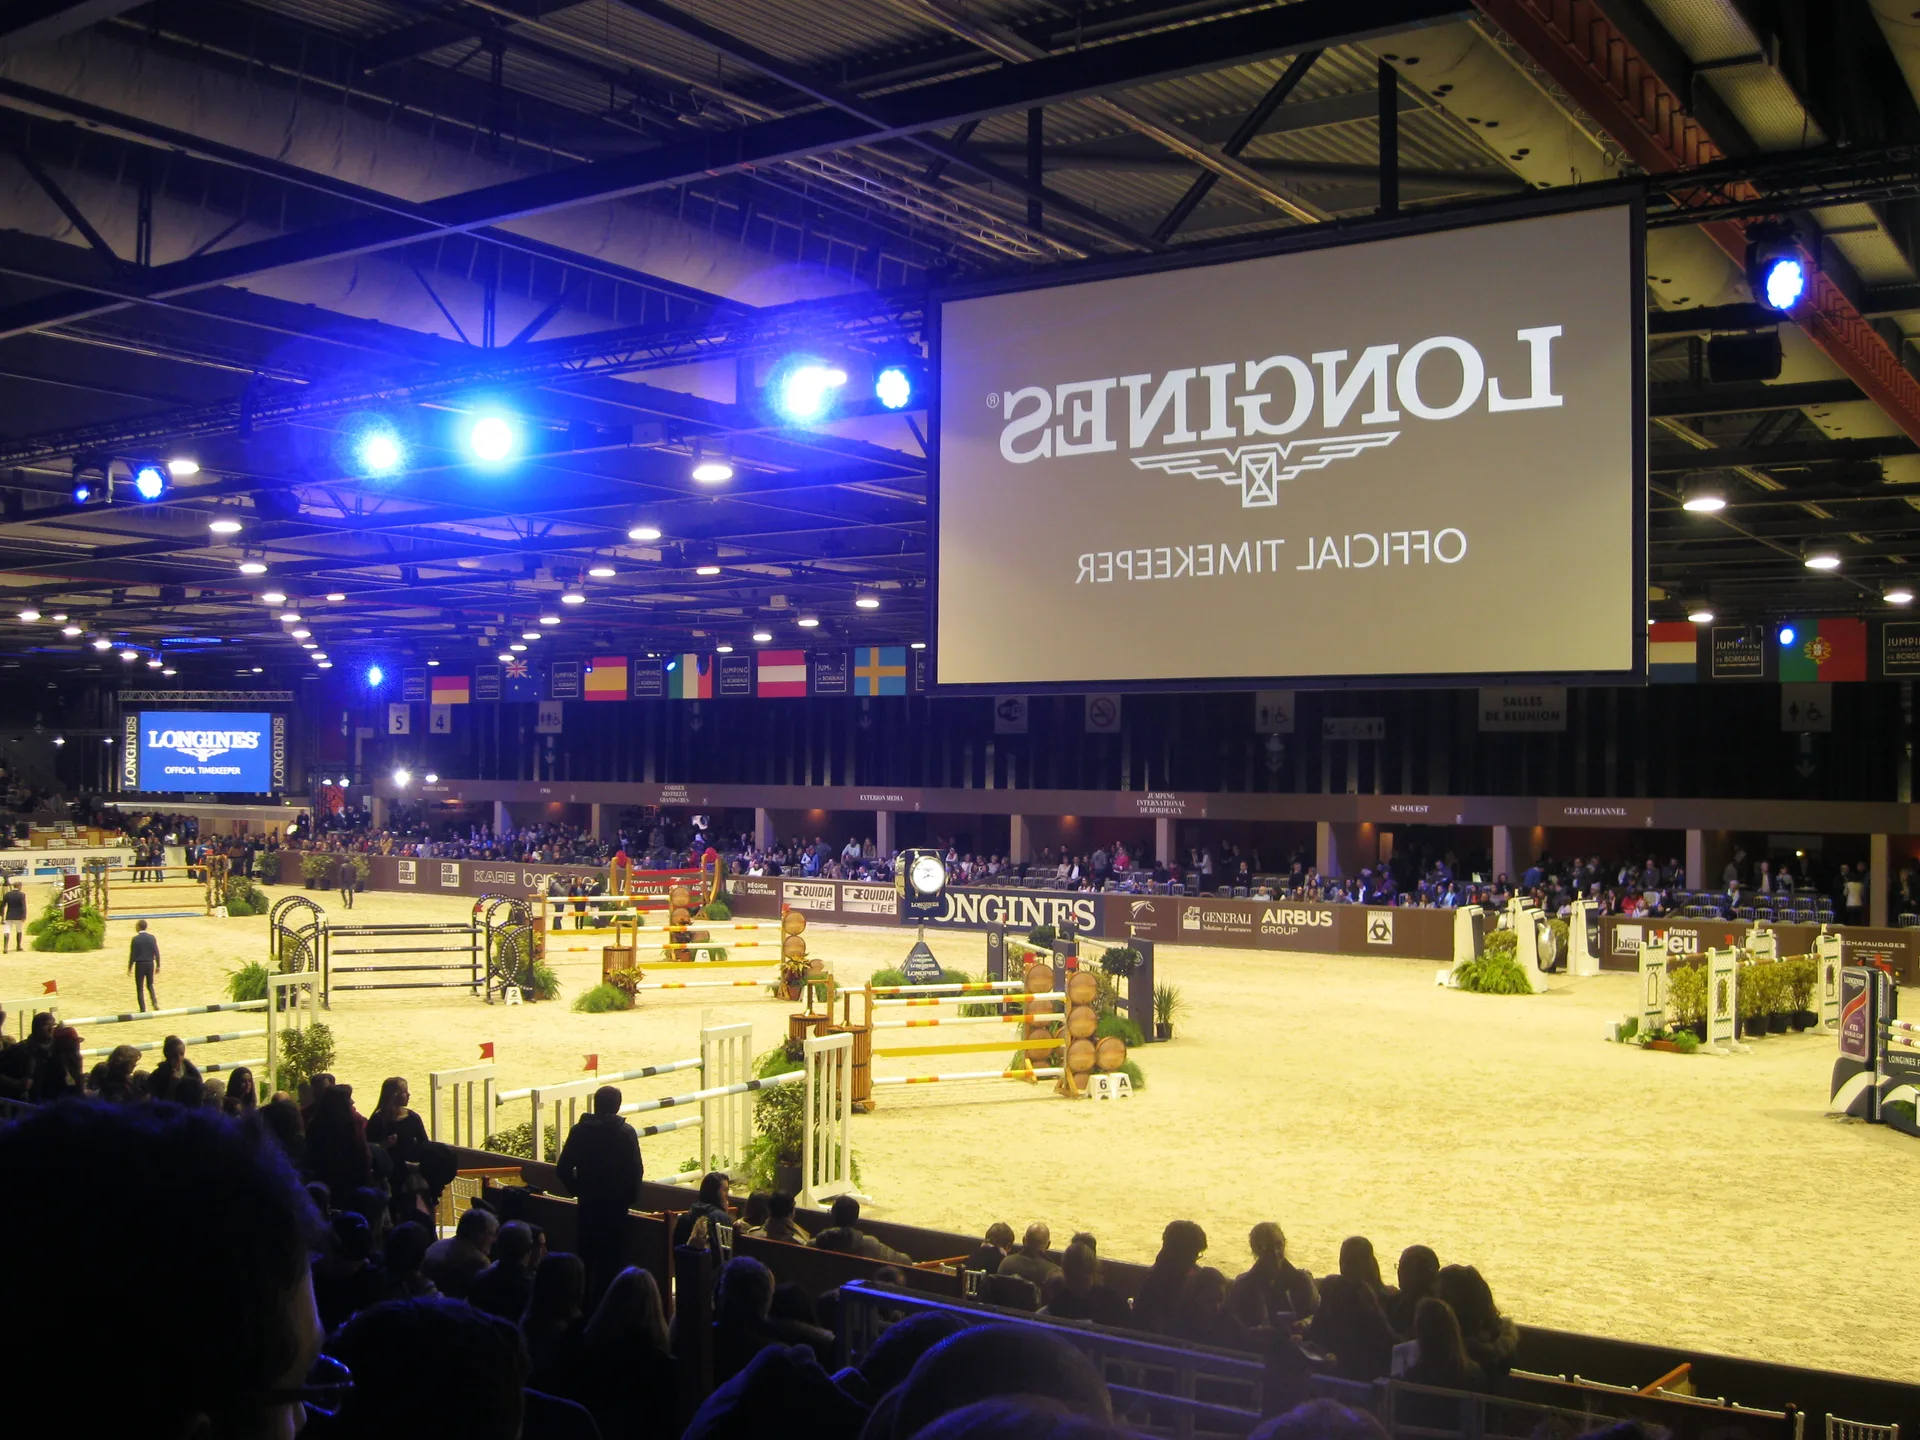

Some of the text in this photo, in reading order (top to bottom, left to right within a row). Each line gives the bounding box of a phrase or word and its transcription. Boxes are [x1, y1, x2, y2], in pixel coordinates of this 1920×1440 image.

[1502, 695, 1543, 707] SALLES
[395, 716, 403, 730] 5
[436, 714, 444, 729] 4
[148, 730, 260, 749] LONGINES
[125, 715, 137, 787] LONGINES
[273, 717, 284, 787] LONGINES
[164, 766, 241, 775] OFFICIAL TIMEKEEPER
[1390, 804, 1405, 812] SUD
[1563, 807, 1627, 815] CLEAR CHANNEL
[399, 862, 409, 871] SUD
[442, 864, 452, 873] SUD
[400, 871, 415, 880] OUEST
[443, 874, 458, 884] OUEST
[474, 869, 515, 884] KARE
[747, 881, 768, 889] RÉGION
[794, 884, 833, 899] EQUIDIA
[854, 888, 895, 902] EQUIDIA
[810, 900, 832, 909] LIFE
[871, 904, 894, 913] LIFE
[932, 892, 1096, 931] ONGINES
[1202, 911, 1252, 925] GENERALI
[1261, 908, 1333, 927] AIRBUS
[1260, 925, 1298, 935] GROUP
[1669, 927, 1697, 936] france
[1619, 938, 1640, 949] bleu
[1843, 975, 1865, 987] LONGINES
[511, 989, 517, 997] 2
[1888, 1055, 1916, 1066] LONGINES
[1100, 1077, 1128, 1090] 6 A
